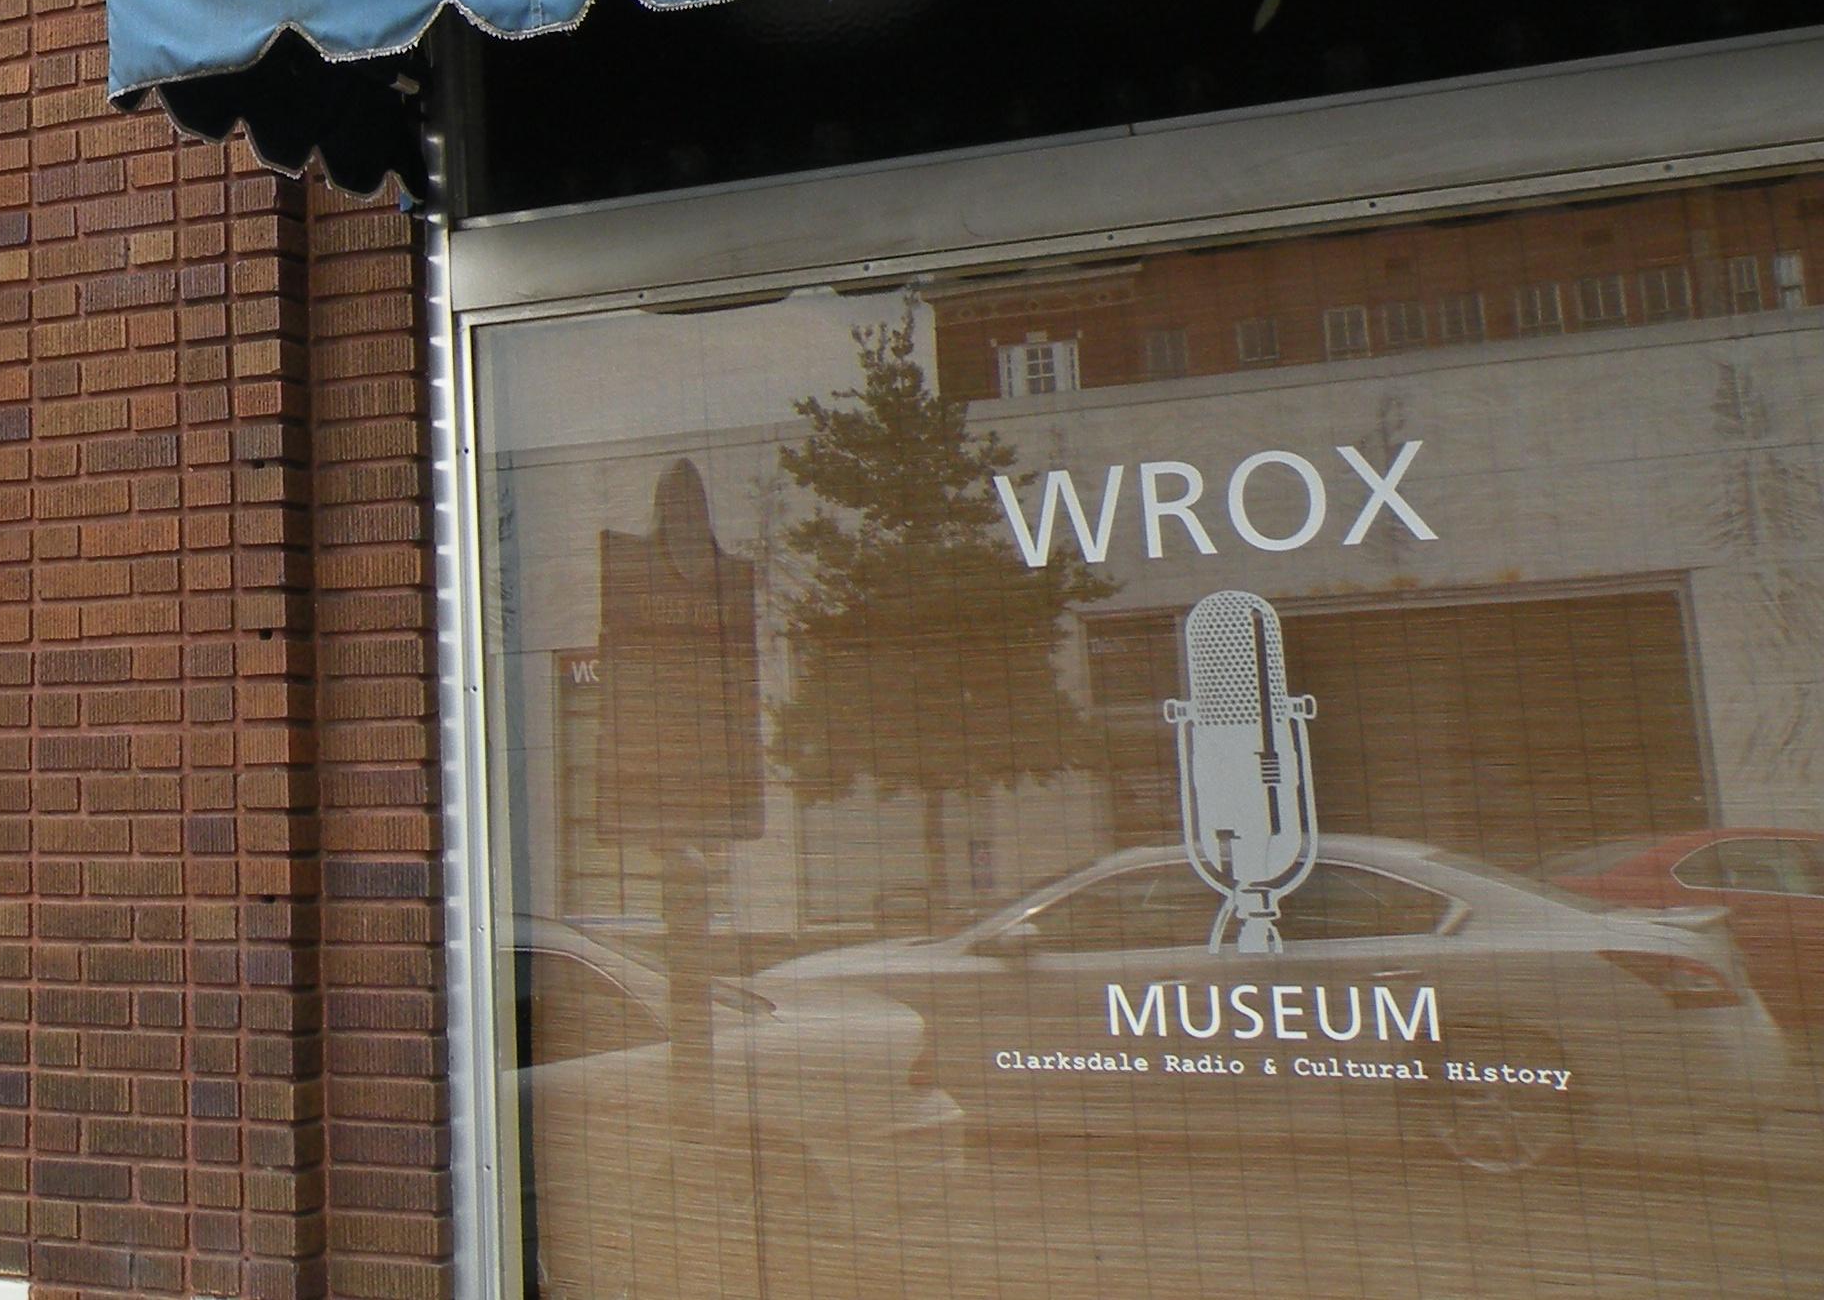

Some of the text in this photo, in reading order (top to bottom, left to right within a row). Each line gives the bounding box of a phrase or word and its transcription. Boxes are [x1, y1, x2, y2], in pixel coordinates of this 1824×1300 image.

[992, 439, 1439, 569] WROX
[1106, 984, 1442, 1042] MUSEUM
[995, 1051, 1572, 1091] Clarksdale Radio & Cultural History
